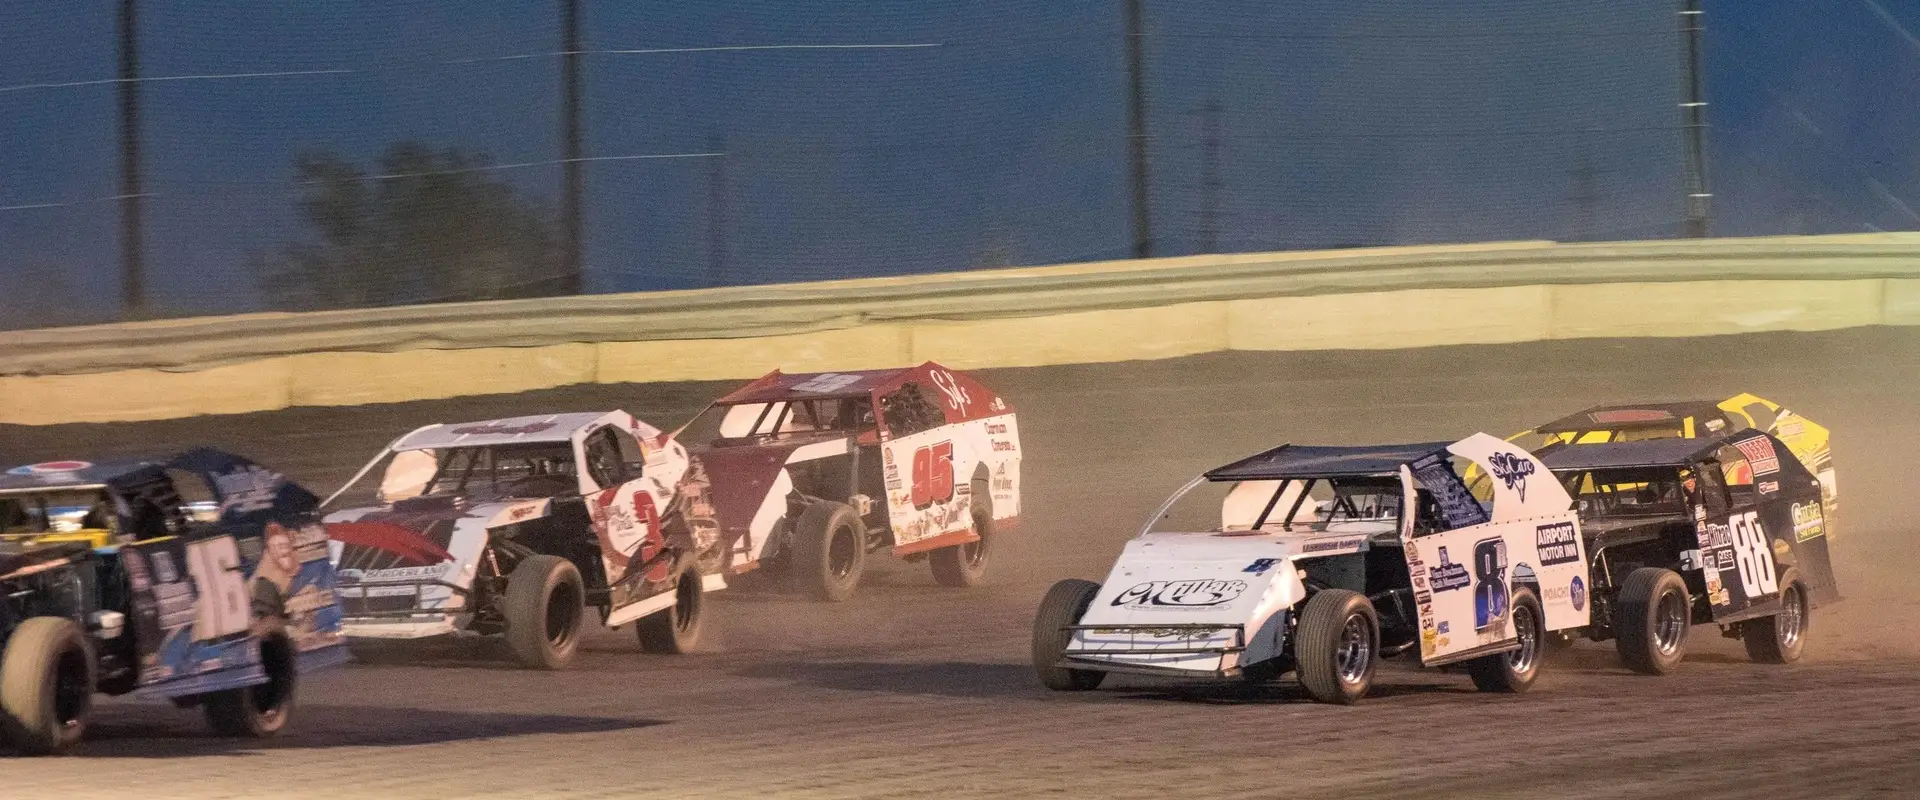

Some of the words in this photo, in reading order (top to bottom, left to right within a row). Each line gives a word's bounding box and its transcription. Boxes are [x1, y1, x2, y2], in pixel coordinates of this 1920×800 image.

[911, 440, 954, 511] 95
[1537, 526, 1574, 545] AIRPORT
[1539, 545, 1564, 561] MOTOR
[1564, 543, 1577, 558] INN
[1718, 550, 1732, 562] CASE
[1729, 511, 1779, 597] 88
[185, 536, 249, 641] 16
[1473, 536, 1510, 630] 8
